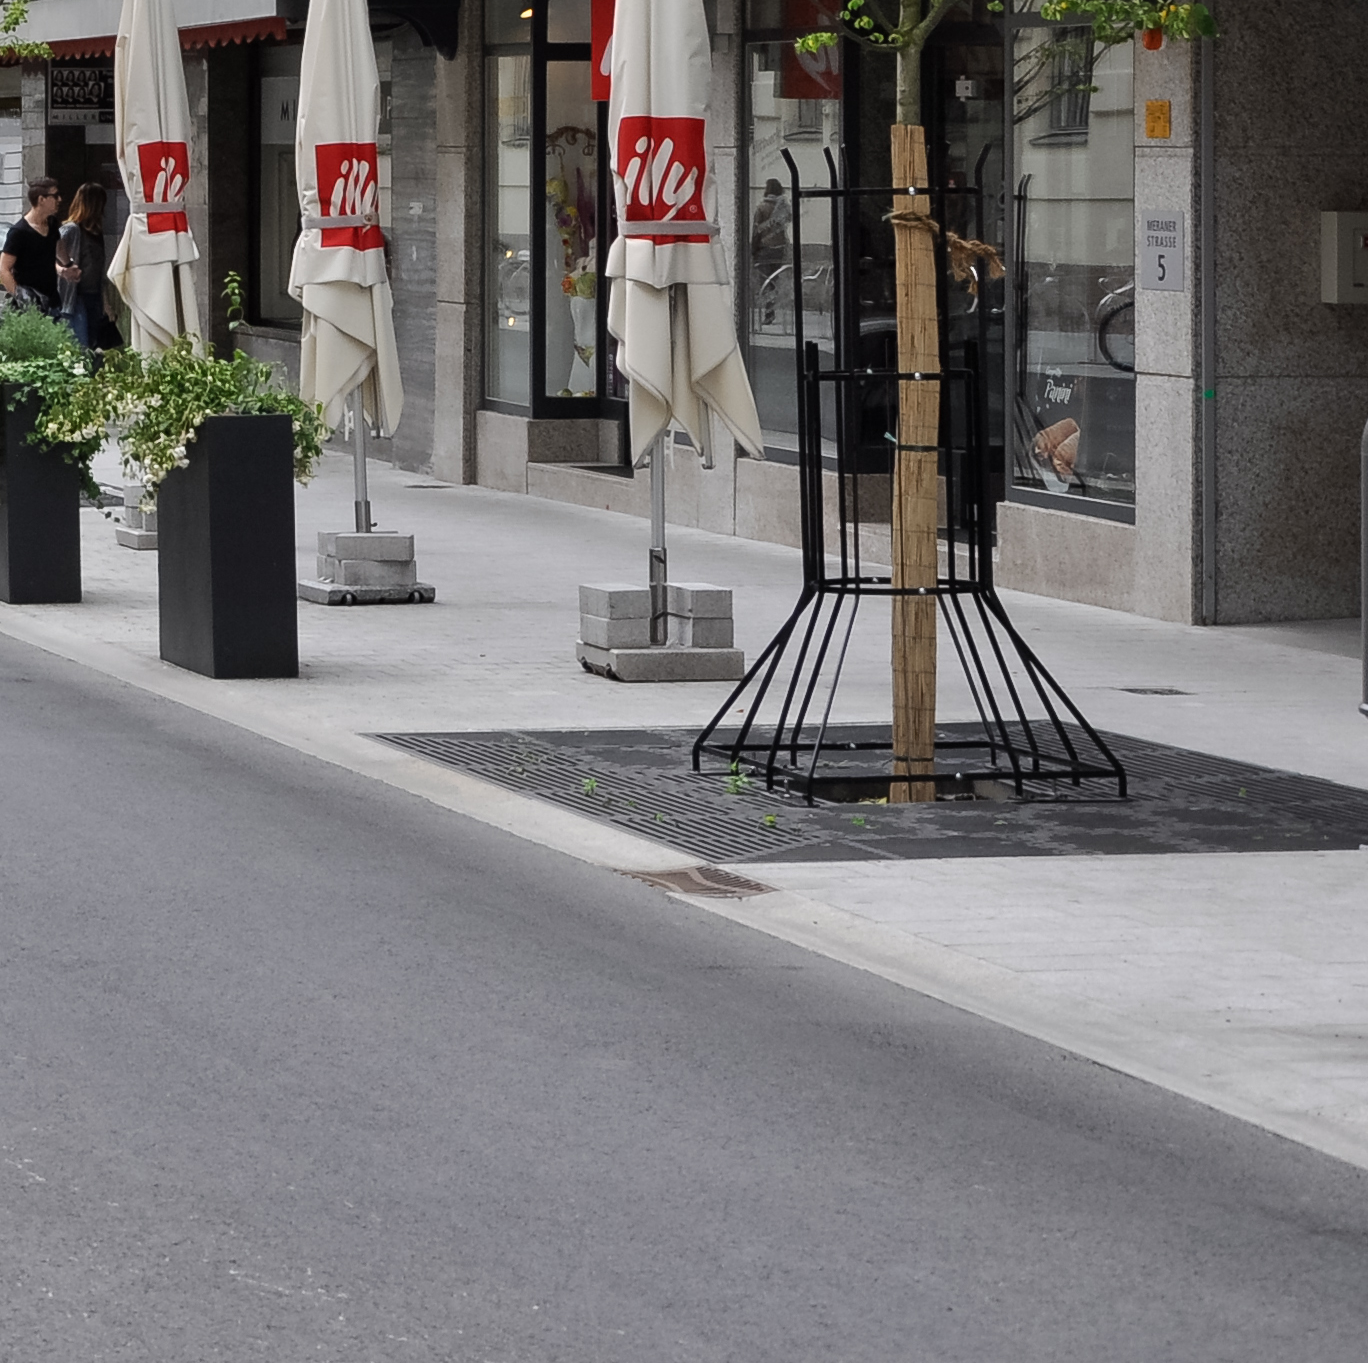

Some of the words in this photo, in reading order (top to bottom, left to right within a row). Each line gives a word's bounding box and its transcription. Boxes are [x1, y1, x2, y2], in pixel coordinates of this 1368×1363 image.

[624, 136, 699, 222] illy
[1146, 220, 1177, 233] MERANER
[1146, 236, 1177, 249] STRASSE
[1157, 254, 1167, 282] 5
